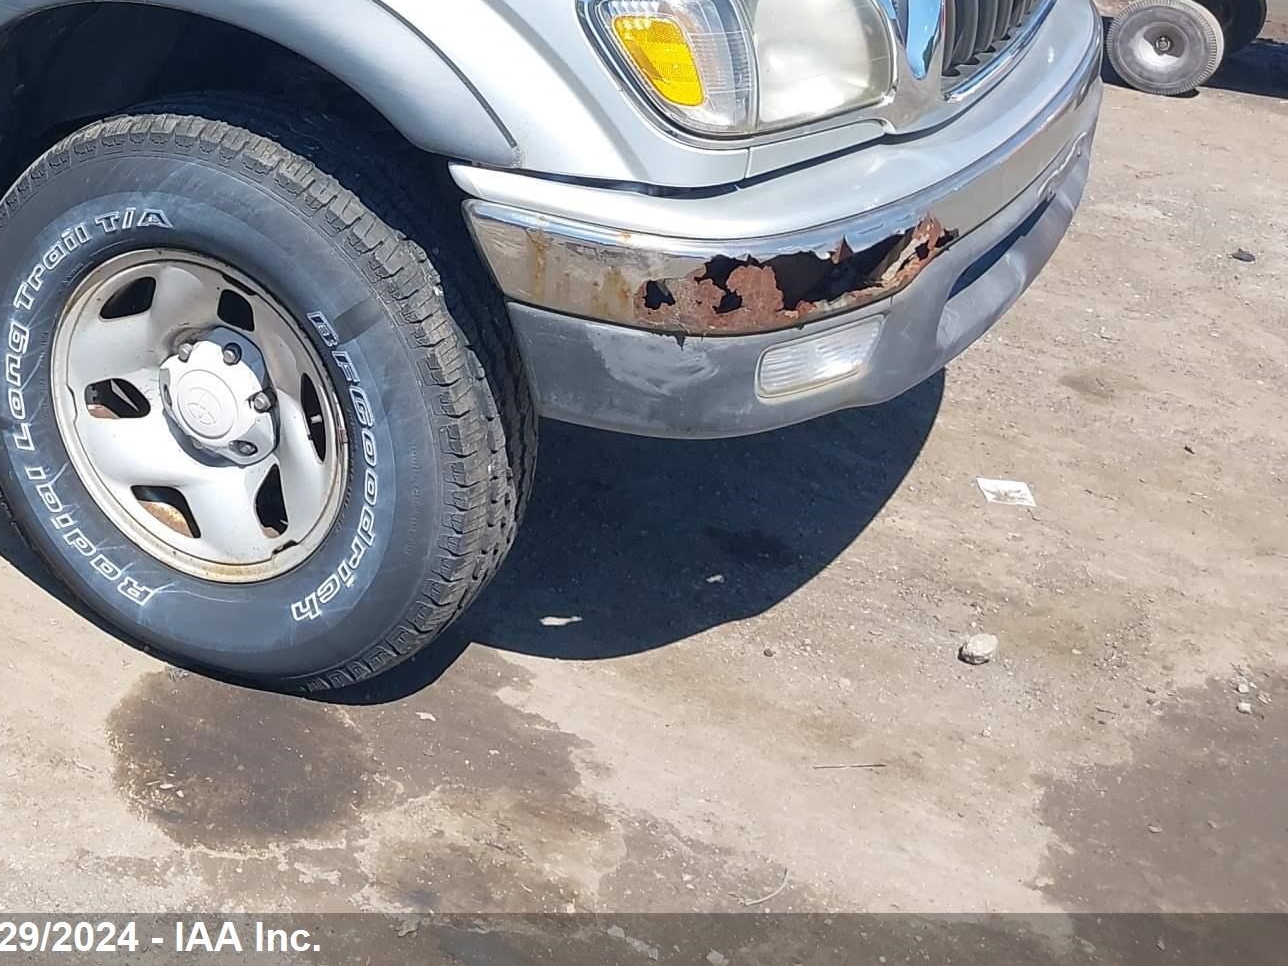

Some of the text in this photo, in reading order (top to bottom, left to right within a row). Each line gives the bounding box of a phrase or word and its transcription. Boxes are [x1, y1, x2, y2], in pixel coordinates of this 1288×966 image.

[6, 206, 175, 606] Radial Long Trail T/A
[290, 310, 378, 622] BFGoodrich
